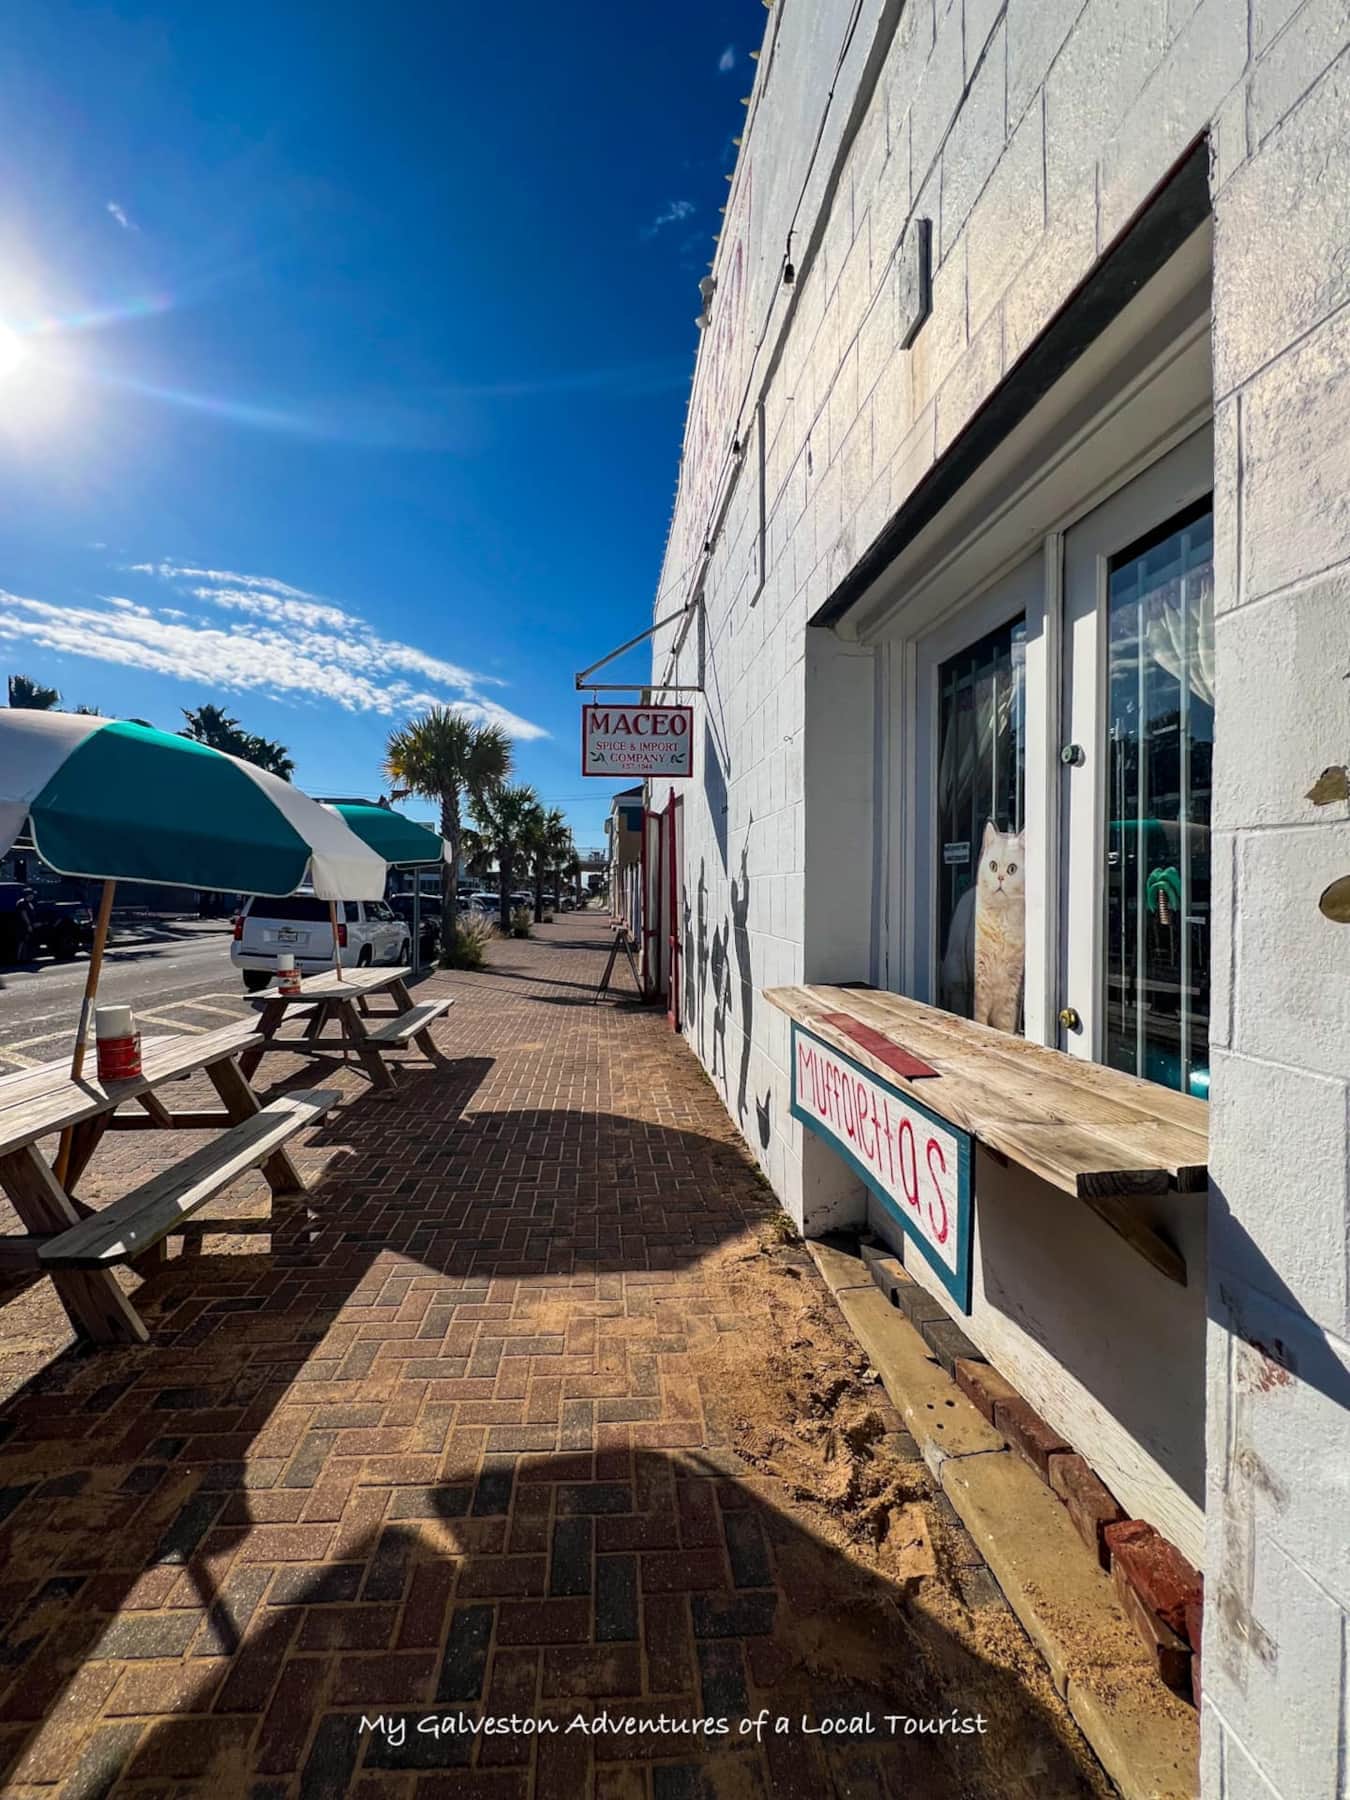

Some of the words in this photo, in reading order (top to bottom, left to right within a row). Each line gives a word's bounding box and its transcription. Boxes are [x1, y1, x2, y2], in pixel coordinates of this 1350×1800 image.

[590, 712, 687, 736] MACEO
[595, 742, 626, 751] SPICE
[630, 743, 636, 751] &
[640, 743, 678, 752] IMPORT
[610, 753, 666, 763] COMPANY
